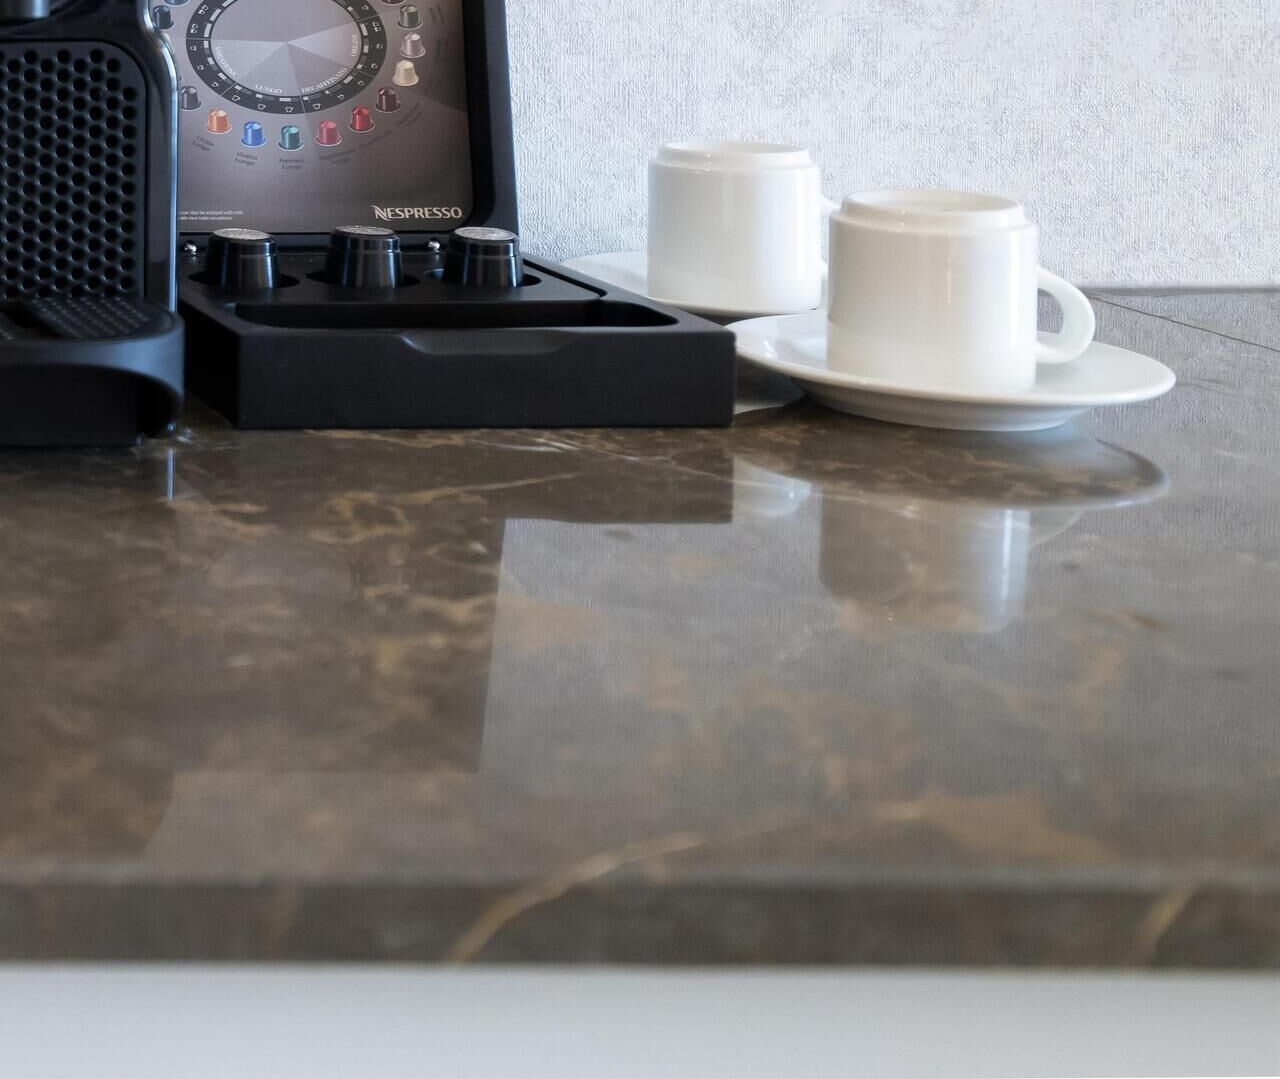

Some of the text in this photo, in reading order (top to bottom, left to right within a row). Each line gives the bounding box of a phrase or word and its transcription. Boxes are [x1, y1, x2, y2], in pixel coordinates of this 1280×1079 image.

[255, 83, 283, 93] LUNGO
[301, 67, 349, 94] DECAFFEINATO
[371, 204, 463, 222] NESPRESSO
